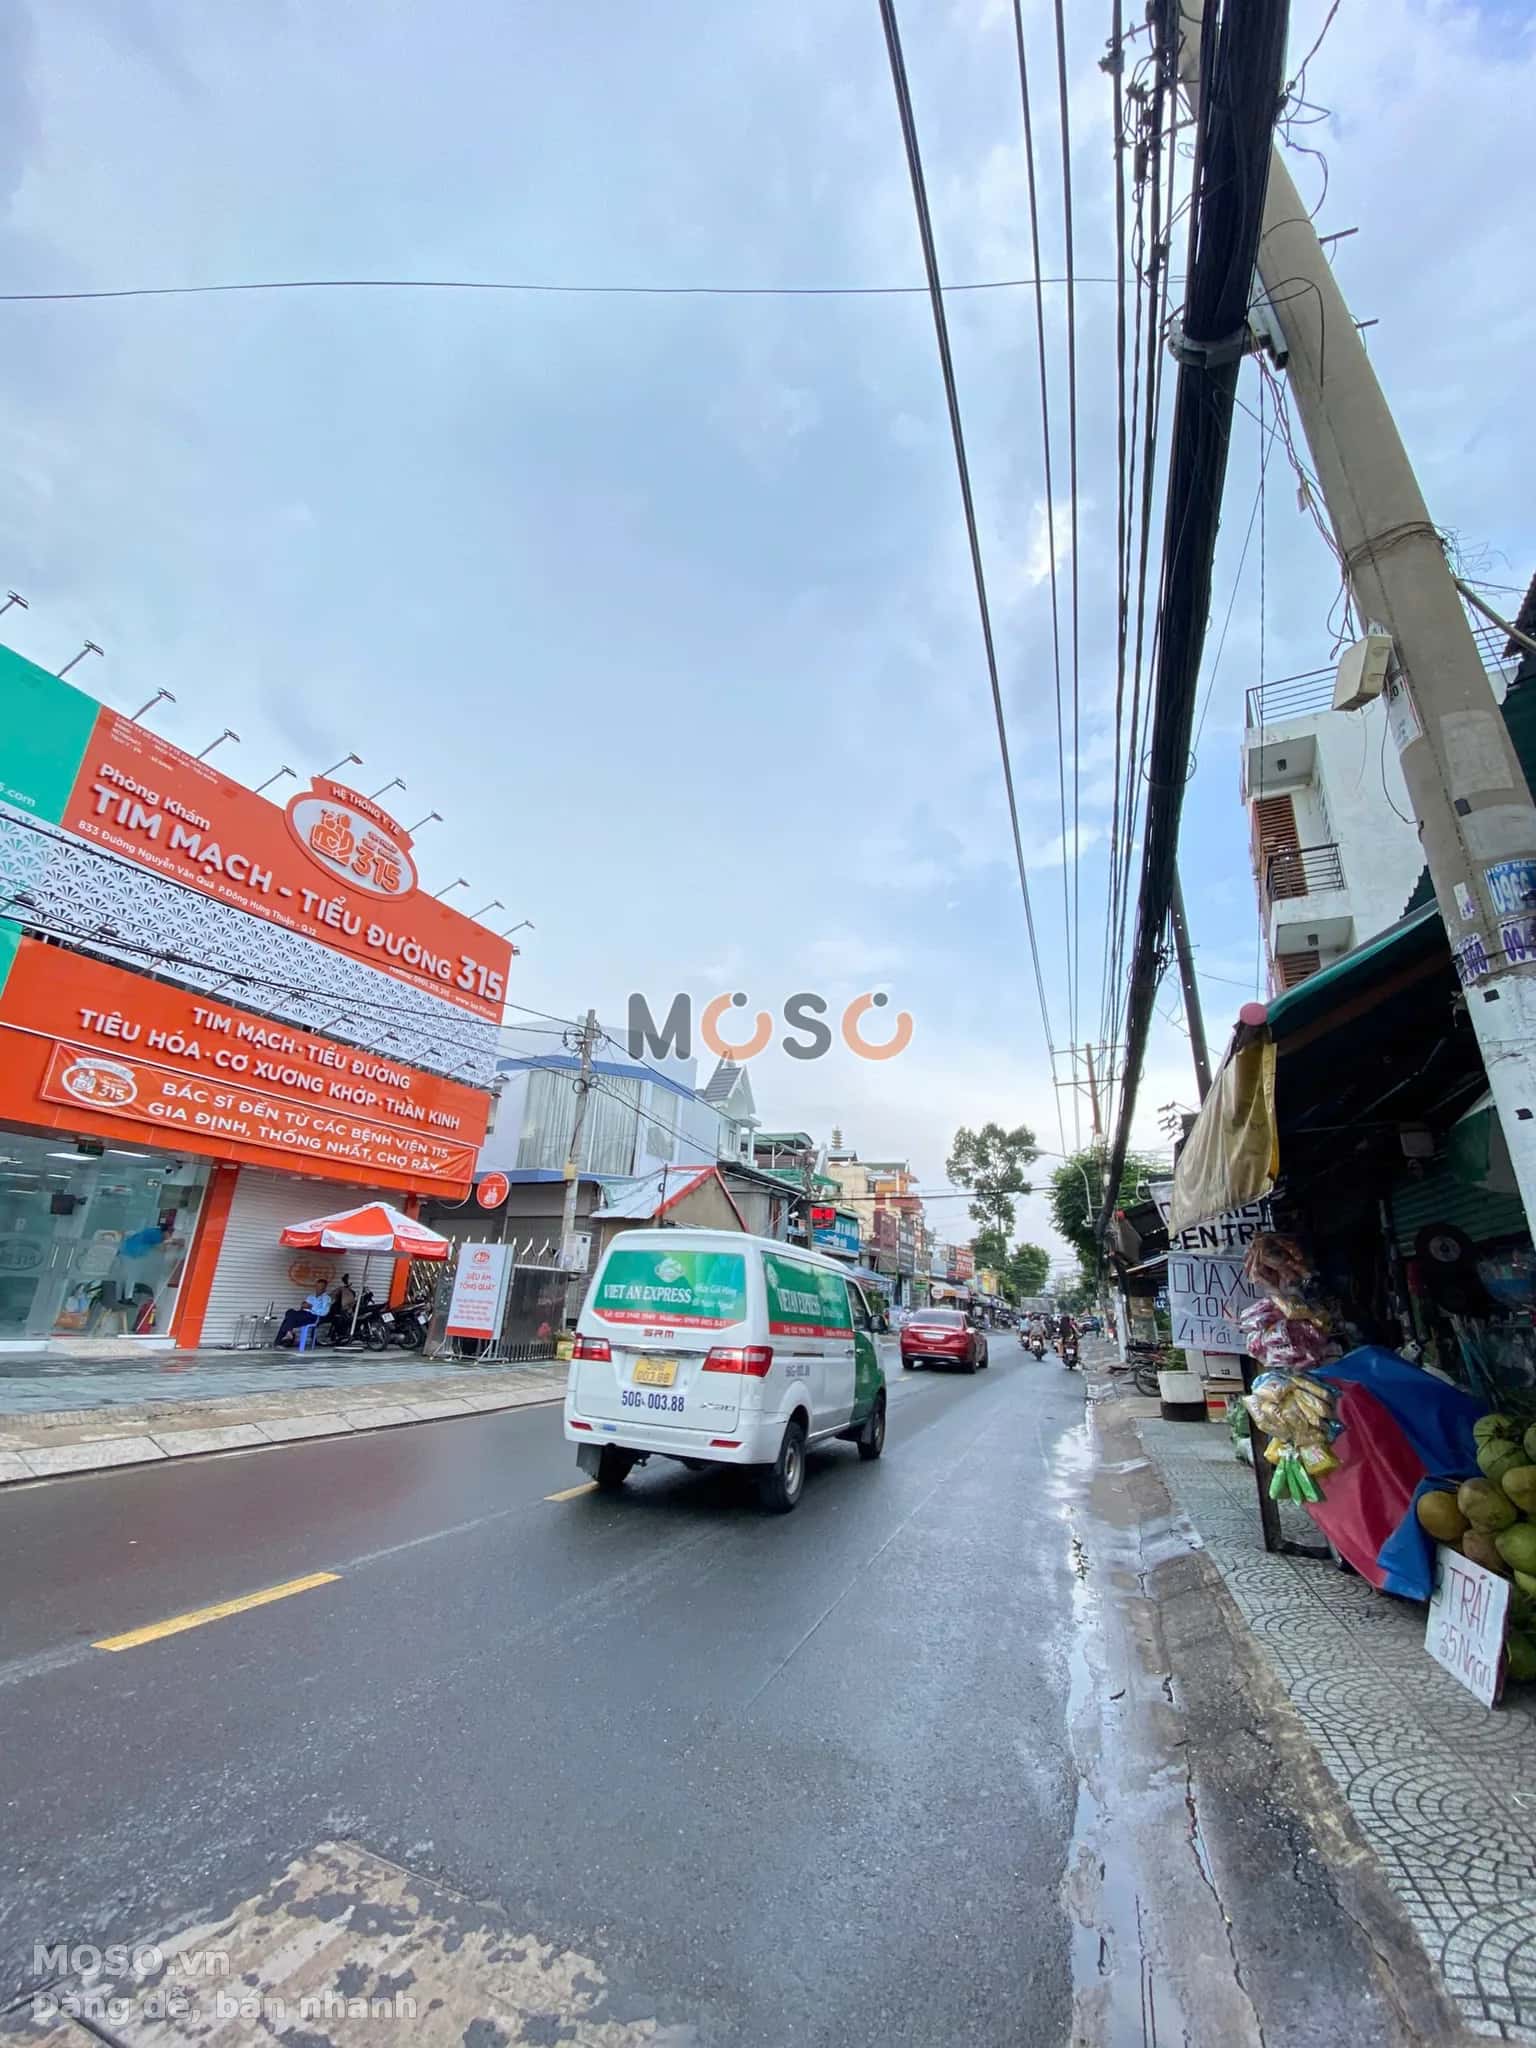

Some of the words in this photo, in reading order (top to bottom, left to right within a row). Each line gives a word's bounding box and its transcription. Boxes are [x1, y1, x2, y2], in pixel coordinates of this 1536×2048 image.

[99, 763, 160, 805] Phòng
[164, 796, 211, 831] Khám
[78, 819, 99, 836] 833
[93, 783, 162, 840] TIM
[168, 825, 273, 893] MẠCH
[301, 888, 362, 935] TIỂU
[366, 923, 452, 979] ĐƯỜNG
[456, 955, 504, 1003] 315
[351, 846, 402, 892] 315
[79, 1008, 141, 1042] TIÊU
[147, 1029, 201, 1061] HÓA
[215, 1049, 249, 1072] CƠ
[253, 1058, 325, 1094] XƯƠNG
[328, 1082, 377, 1107] KHỚP
[428, 1109, 461, 1131] KINH
[193, 1006, 232, 1034] TIM
[236, 1021, 296, 1054] MẠCH
[306, 1042, 347, 1070] TIỂU
[351, 1059, 411, 1090] ĐƯỜNG
[97, 1085, 125, 1100] 315
[161, 1082, 209, 1104] BÁC
[212, 1094, 236, 1110] SĨ
[238, 1099, 280, 1122] ĐẾN
[284, 1110, 310, 1127] TỪ
[312, 1117, 347, 1137] CÁC
[351, 1127, 392, 1148] BỆNH
[395, 1136, 429, 1155] VIỆN
[148, 1102, 188, 1121] GIA
[194, 1111, 252, 1138] ĐỊNH,
[258, 1125, 322, 1150] THỐNG
[376, 1150, 409, 1168] CHỢ
[643, 1286, 692, 1304] EXPRESS
[1191, 1296, 1233, 1319] 10K
[1179, 1319, 1194, 1345] 4
